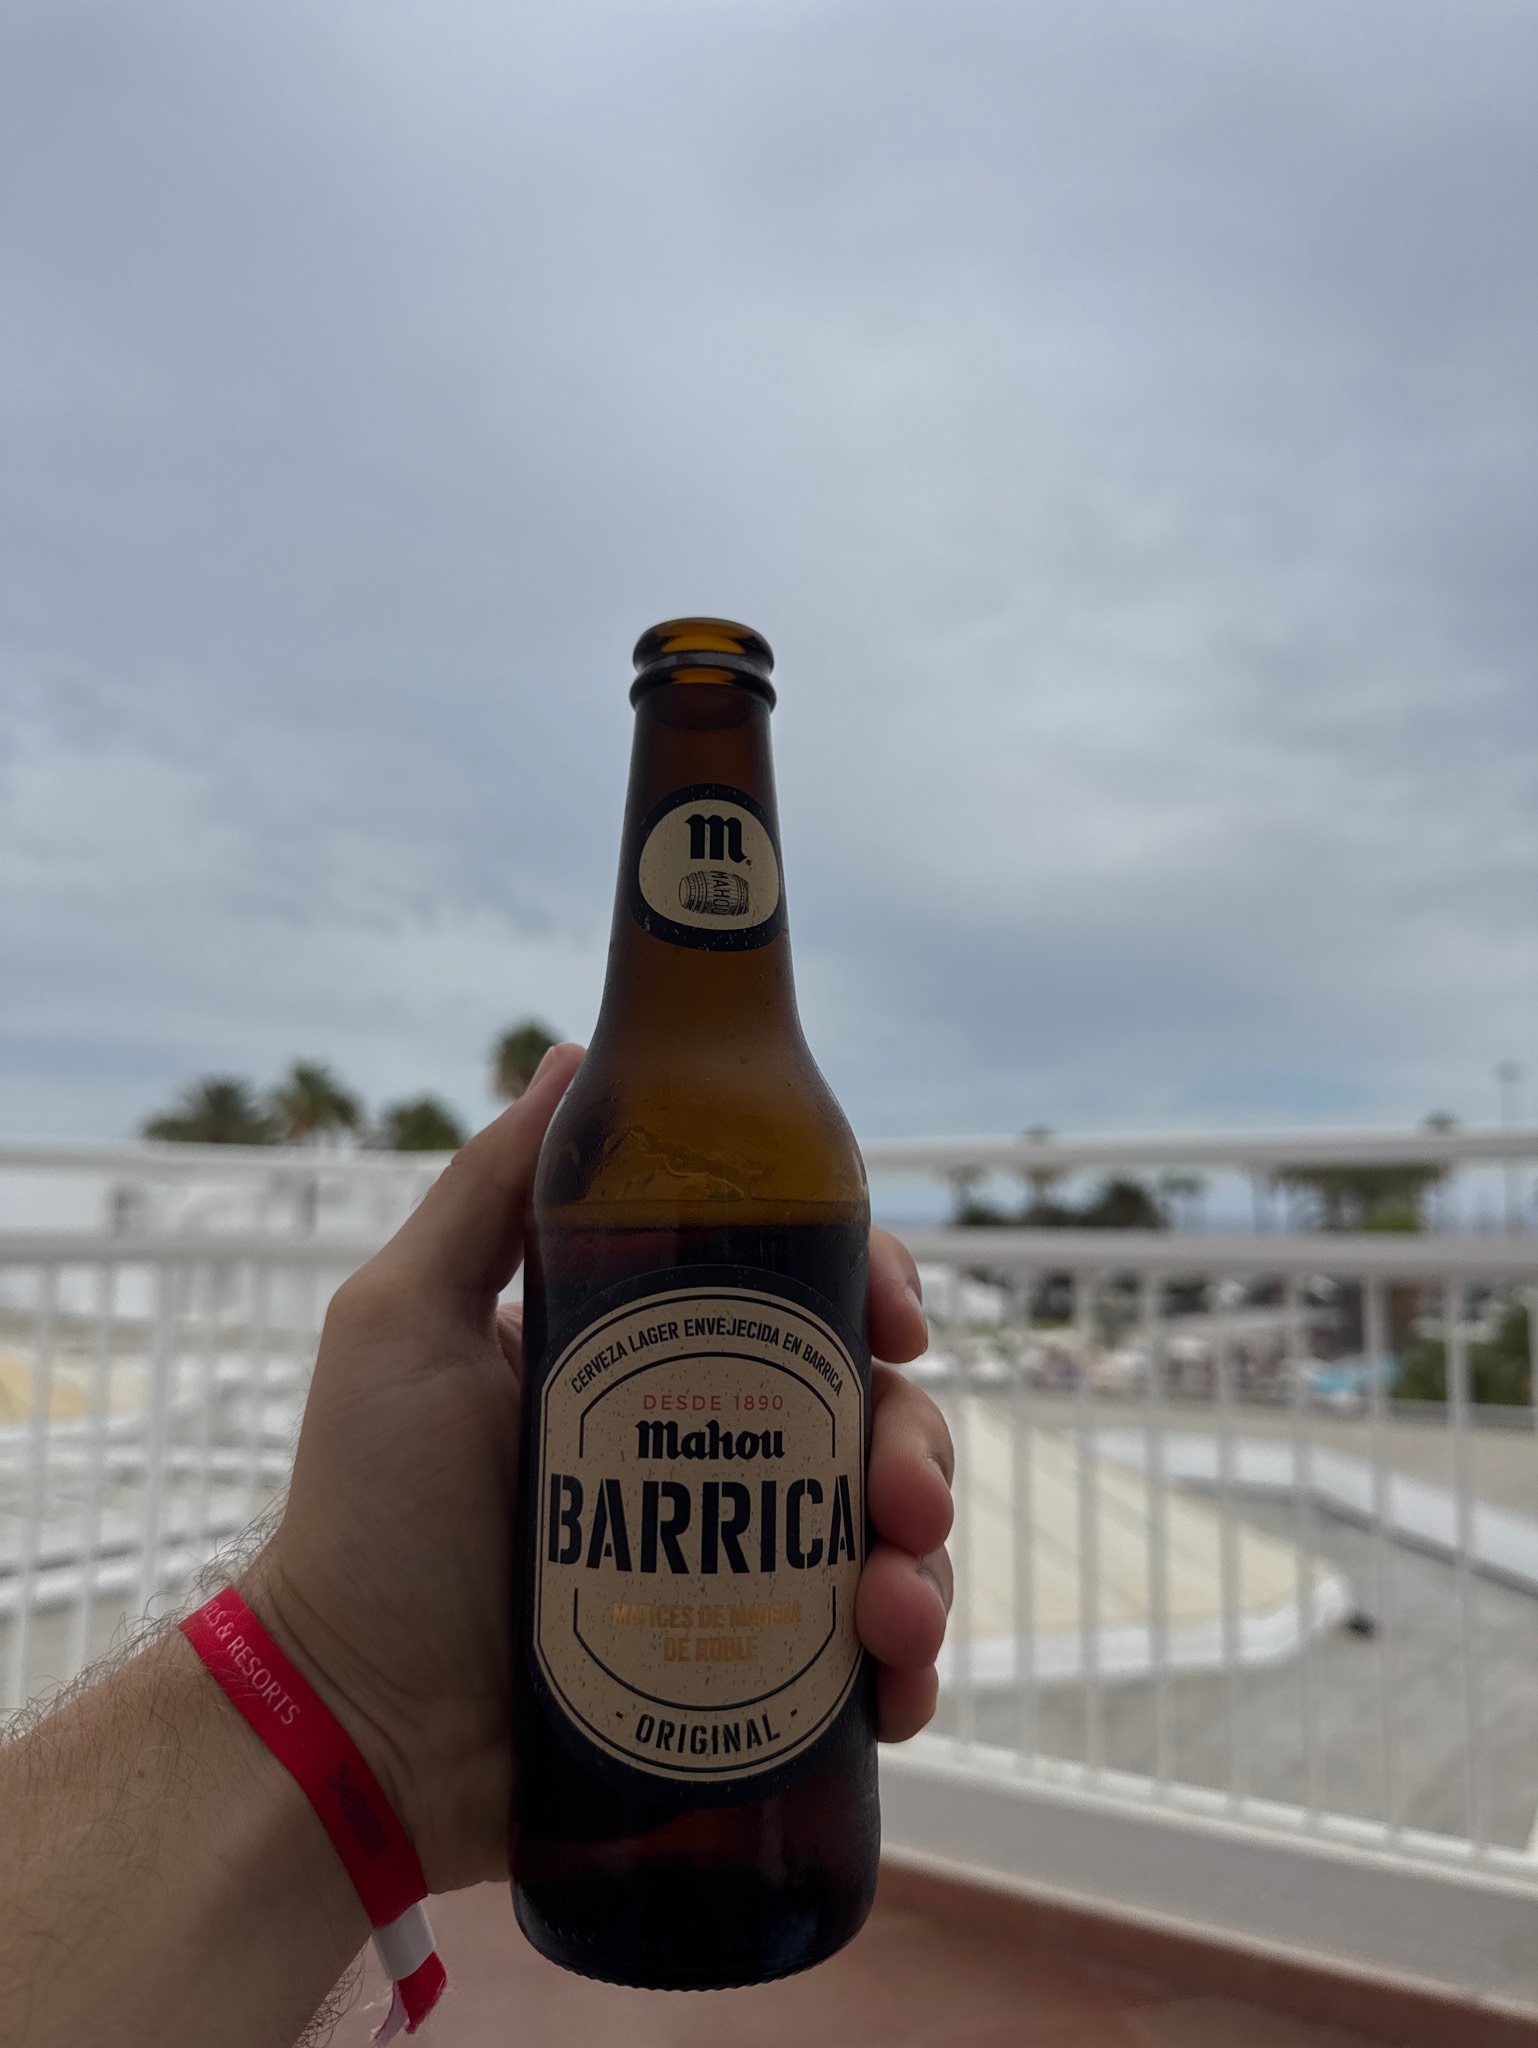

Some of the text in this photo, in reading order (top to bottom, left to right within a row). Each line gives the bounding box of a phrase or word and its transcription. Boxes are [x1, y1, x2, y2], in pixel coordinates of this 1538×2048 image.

[710, 871, 731, 916] MAHOU
[571, 1317, 844, 1398] CERVEZA LAGER ENVEJECIDA EN BARRICA
[643, 1394, 784, 1411] DESDE 1890
[547, 1473, 856, 1575] BARRICA
[612, 1602, 694, 1629] MATICES
[698, 1603, 725, 1629] DE
[663, 1636, 758, 1663] DE ROBLE
[215, 1622, 235, 1642] &
[226, 1635, 301, 1725] RESORTS
[635, 1713, 781, 1755] ORIGINAL
